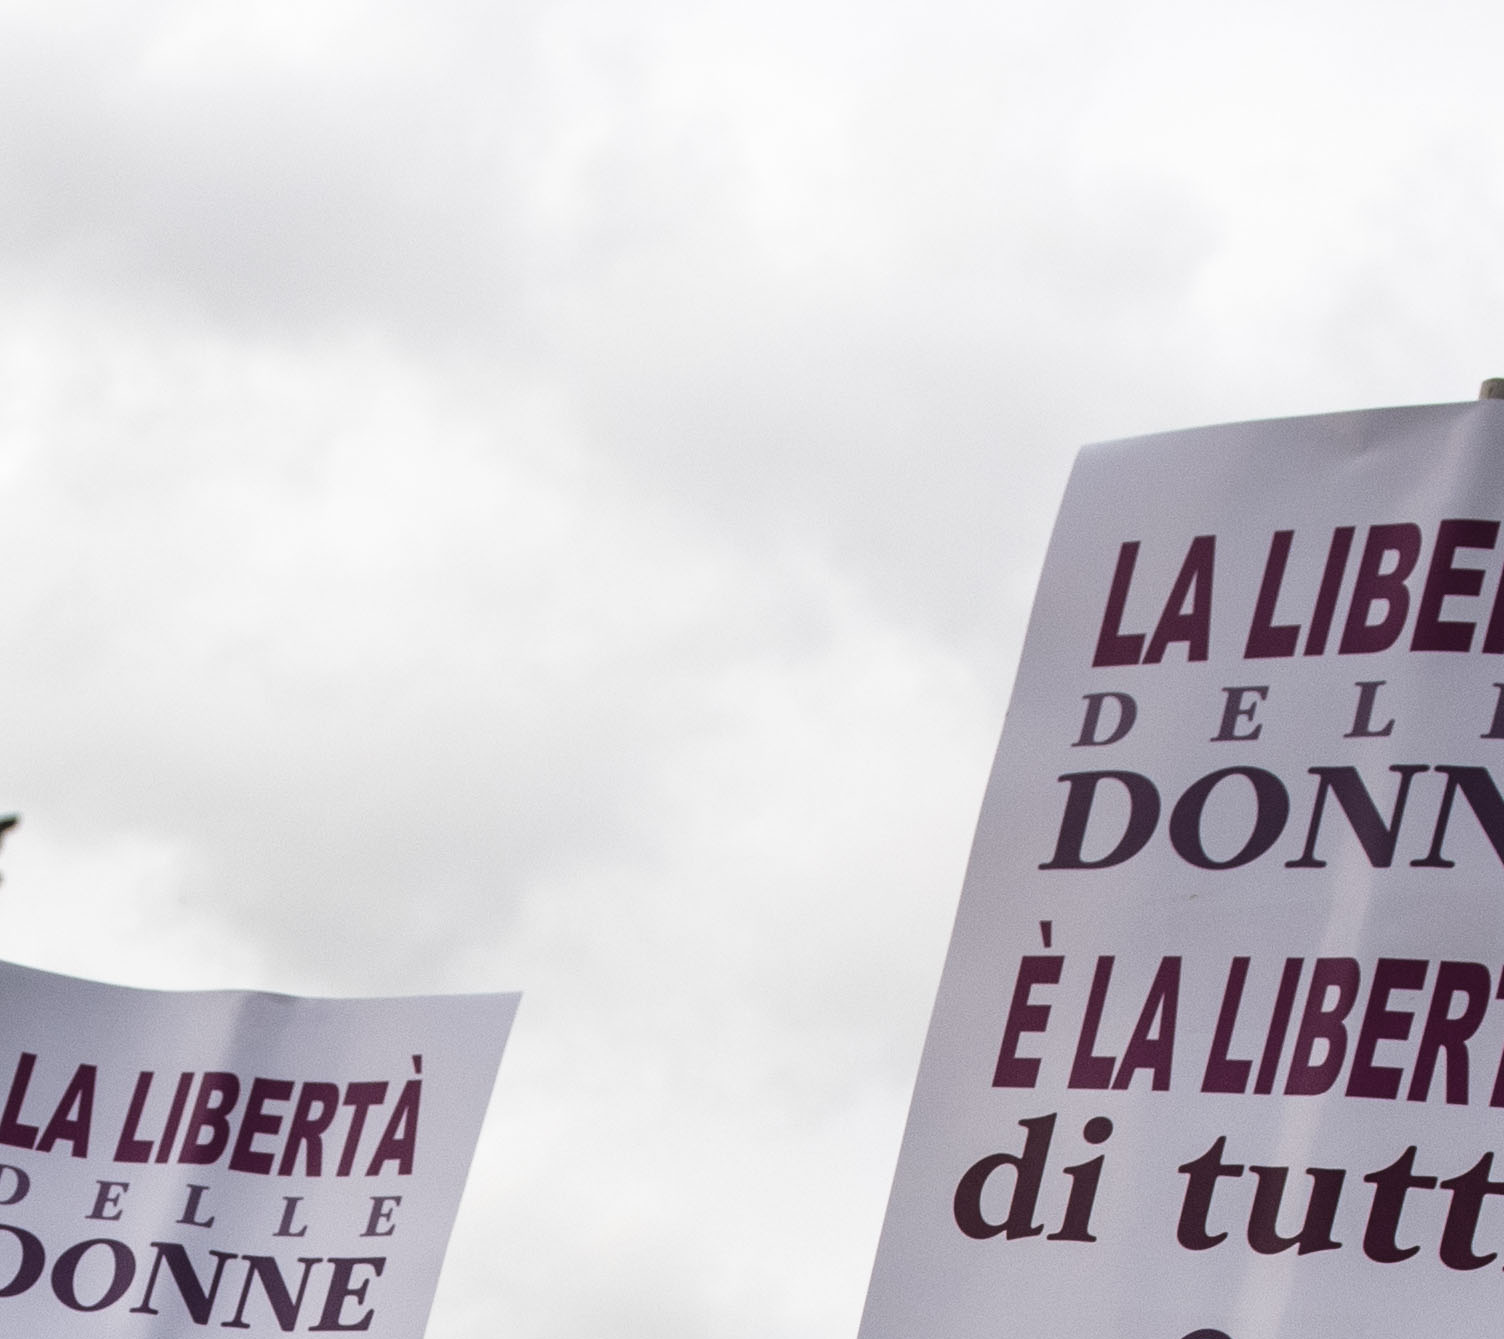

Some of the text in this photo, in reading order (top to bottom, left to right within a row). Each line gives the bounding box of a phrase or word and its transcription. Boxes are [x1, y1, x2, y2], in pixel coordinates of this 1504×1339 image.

[1091, 535, 1216, 668] LA
[991, 920, 1066, 1090] È
[1067, 954, 1184, 1093] LA
[113, 1054, 424, 1177] LIBERTÀ
[953, 1112, 1114, 1245] di
